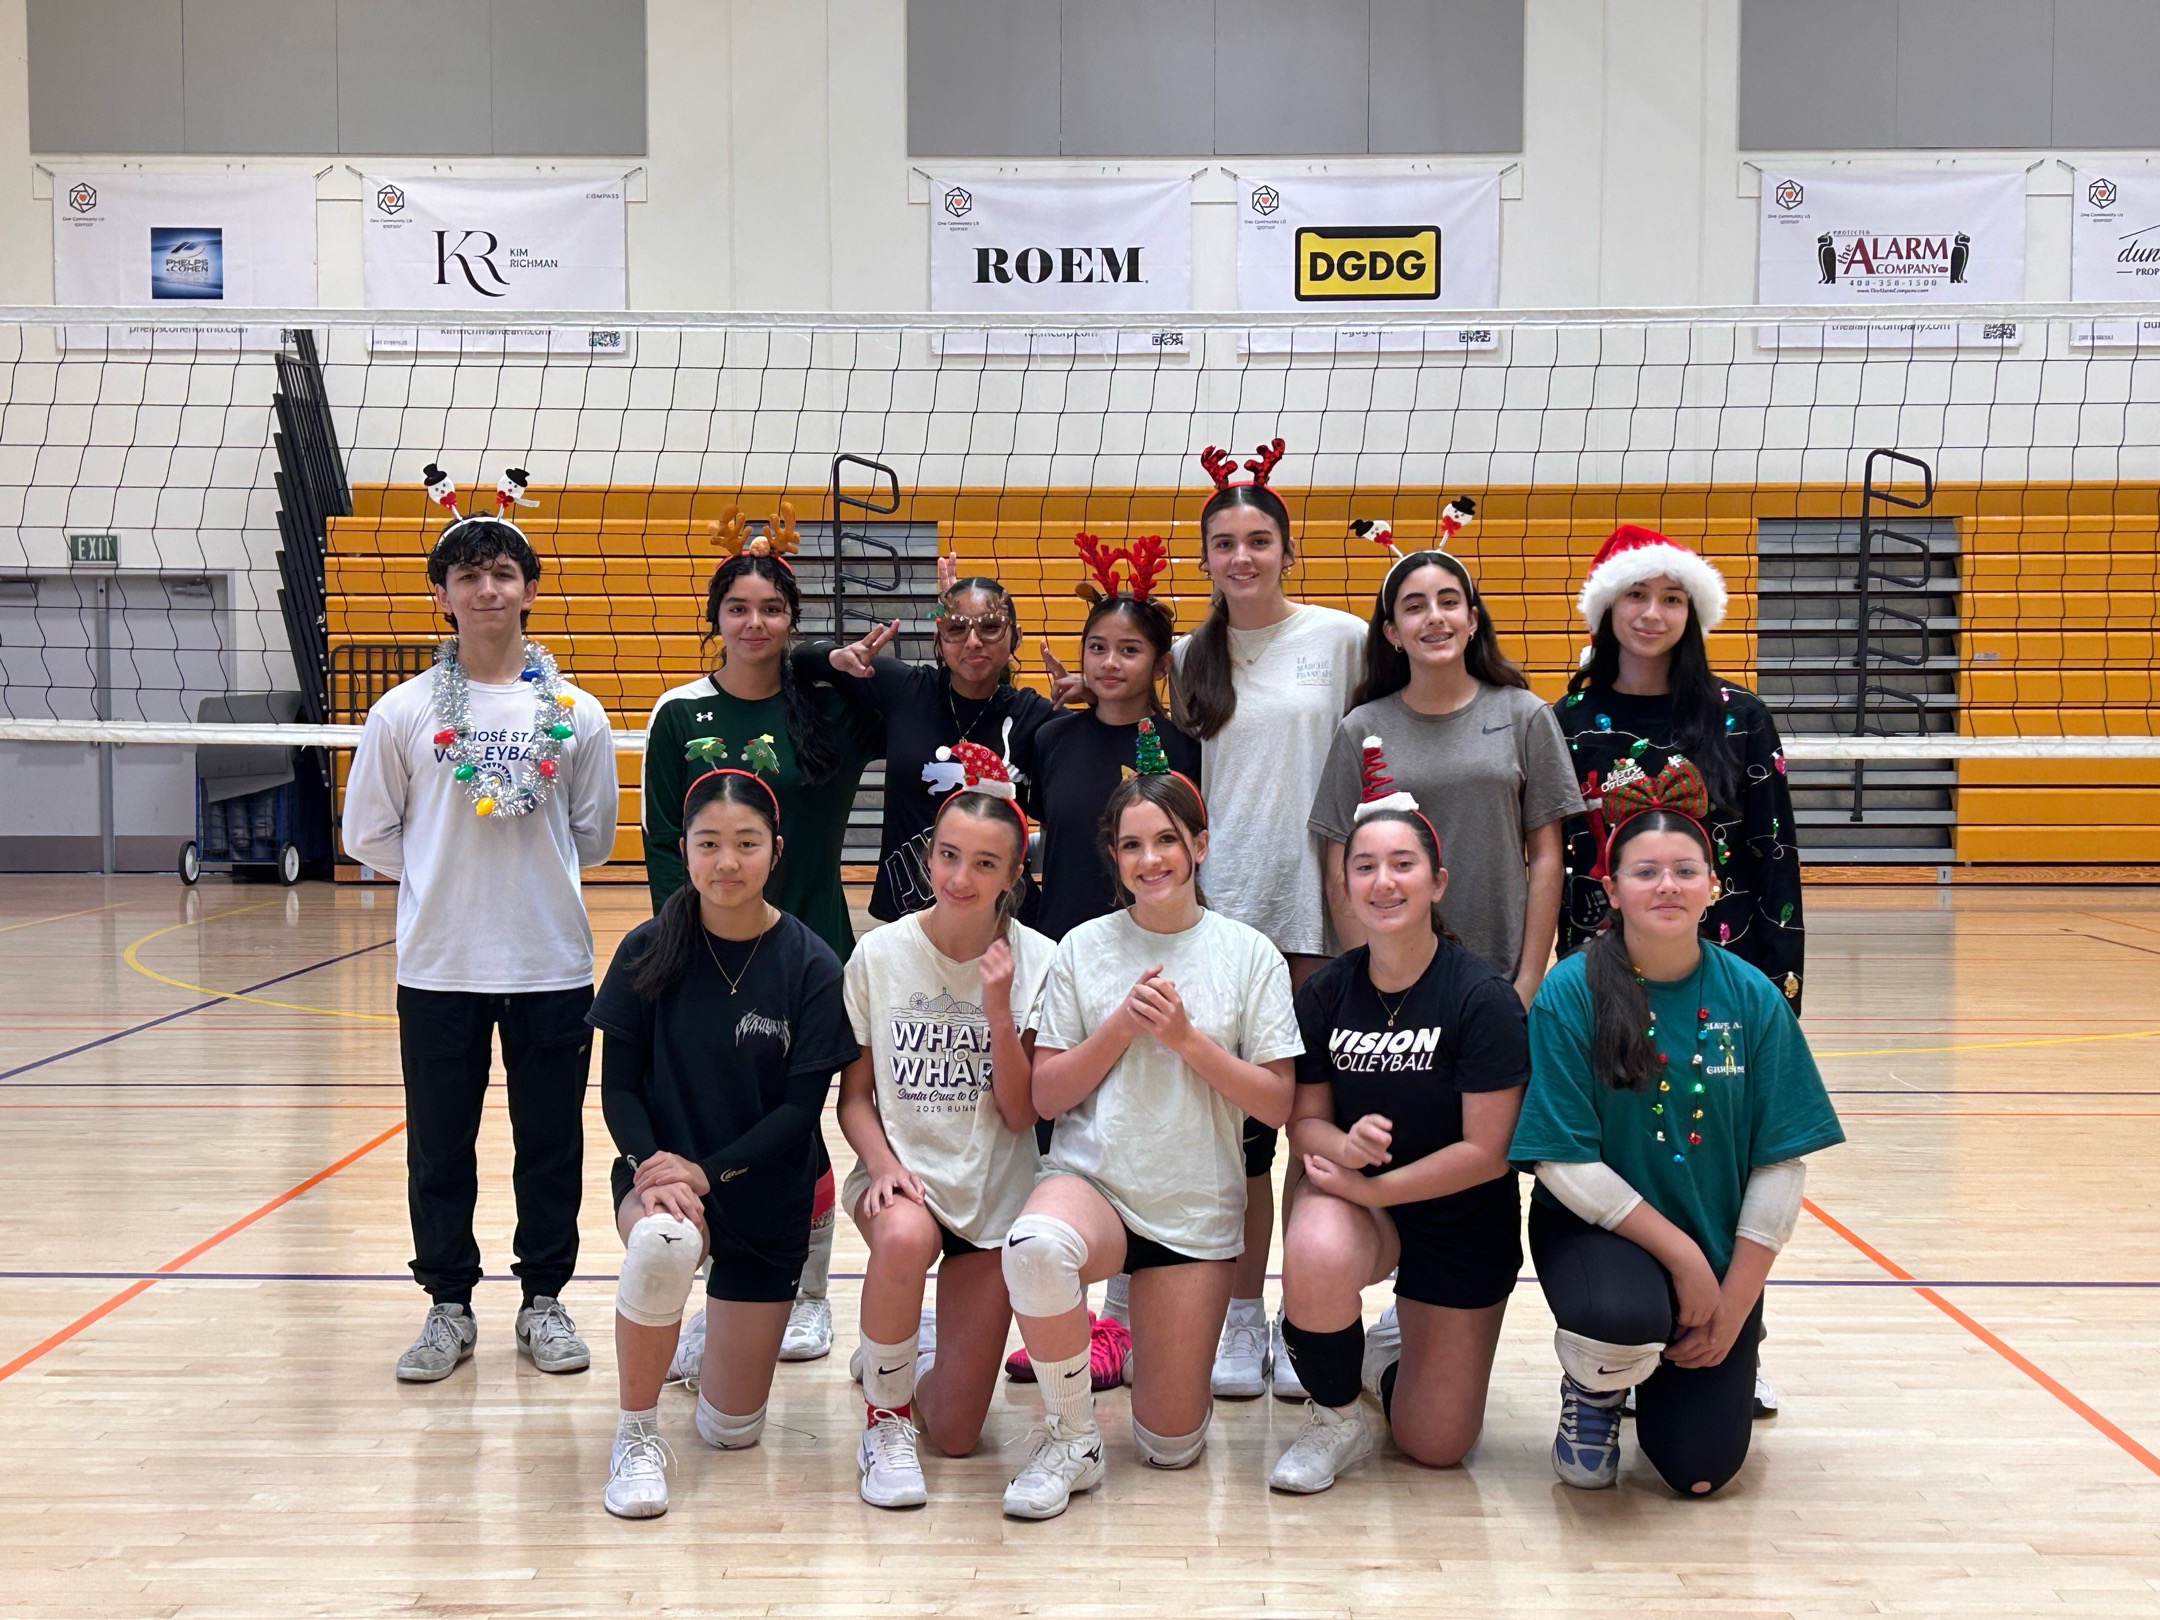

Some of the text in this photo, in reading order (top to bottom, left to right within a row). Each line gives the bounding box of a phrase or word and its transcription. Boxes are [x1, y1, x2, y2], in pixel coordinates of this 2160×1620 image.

[509, 248, 528, 258] KIM
[1837, 237, 1949, 275] the ALARM
[509, 259, 559, 268] RICHMAN
[972, 247, 1146, 284] ROEM
[1309, 250, 1427, 281] DGDG
[1876, 263, 1939, 275] COMPANY
[78, 537, 112, 560] EXIT
[1328, 1027, 1442, 1054] VISION
[943, 1047, 970, 1063] TO
[1330, 1052, 1434, 1072] VOLLEYBALL
[897, 1088, 928, 1101] Santa
[928, 1089, 955, 1102] Cruz
[956, 1091, 967, 1101] to
[916, 1105, 942, 1113] 2025
